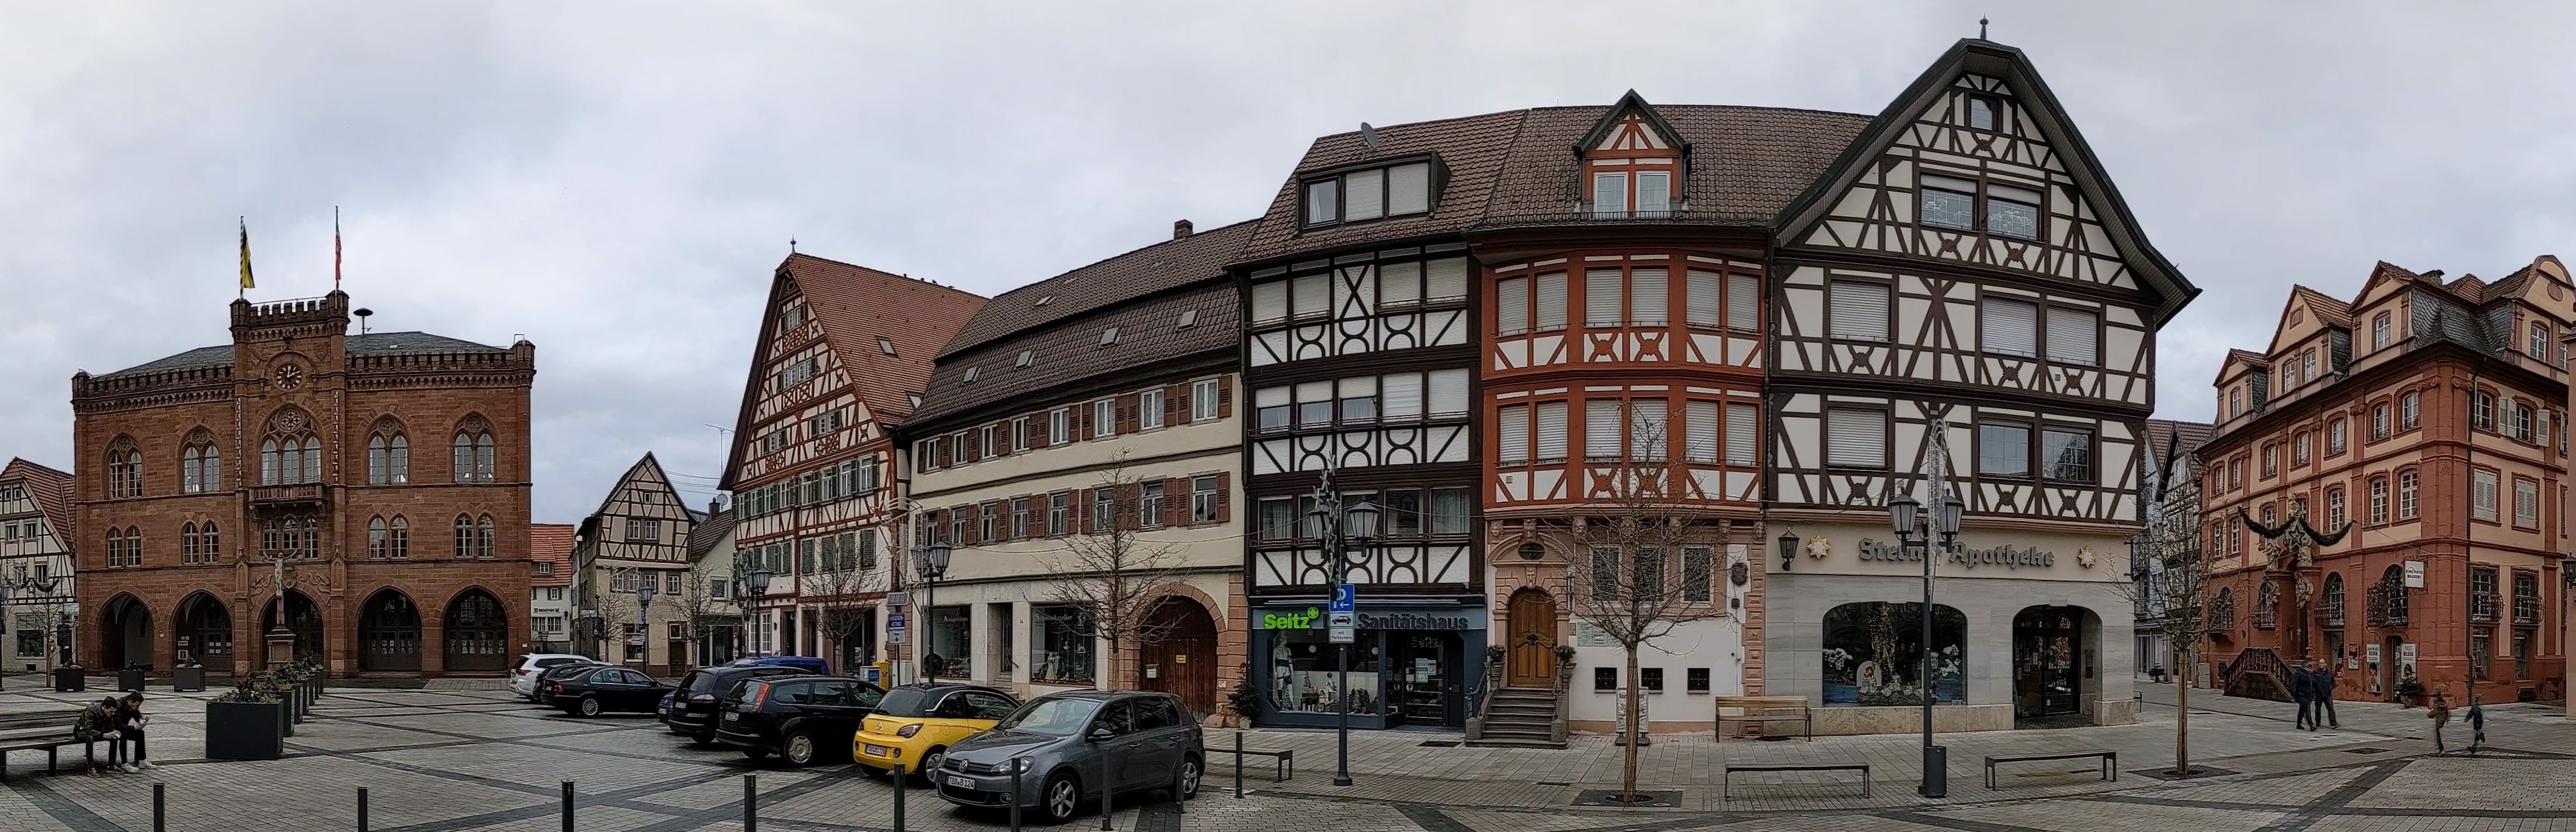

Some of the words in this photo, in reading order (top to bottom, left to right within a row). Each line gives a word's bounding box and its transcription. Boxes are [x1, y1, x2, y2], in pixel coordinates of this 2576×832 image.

[1949, 541, 2055, 569] Apotheke
[1264, 613, 1310, 629] Seitz
[1358, 613, 1469, 630] Sanitätshaus
[949, 776, 958, 785] TBB
